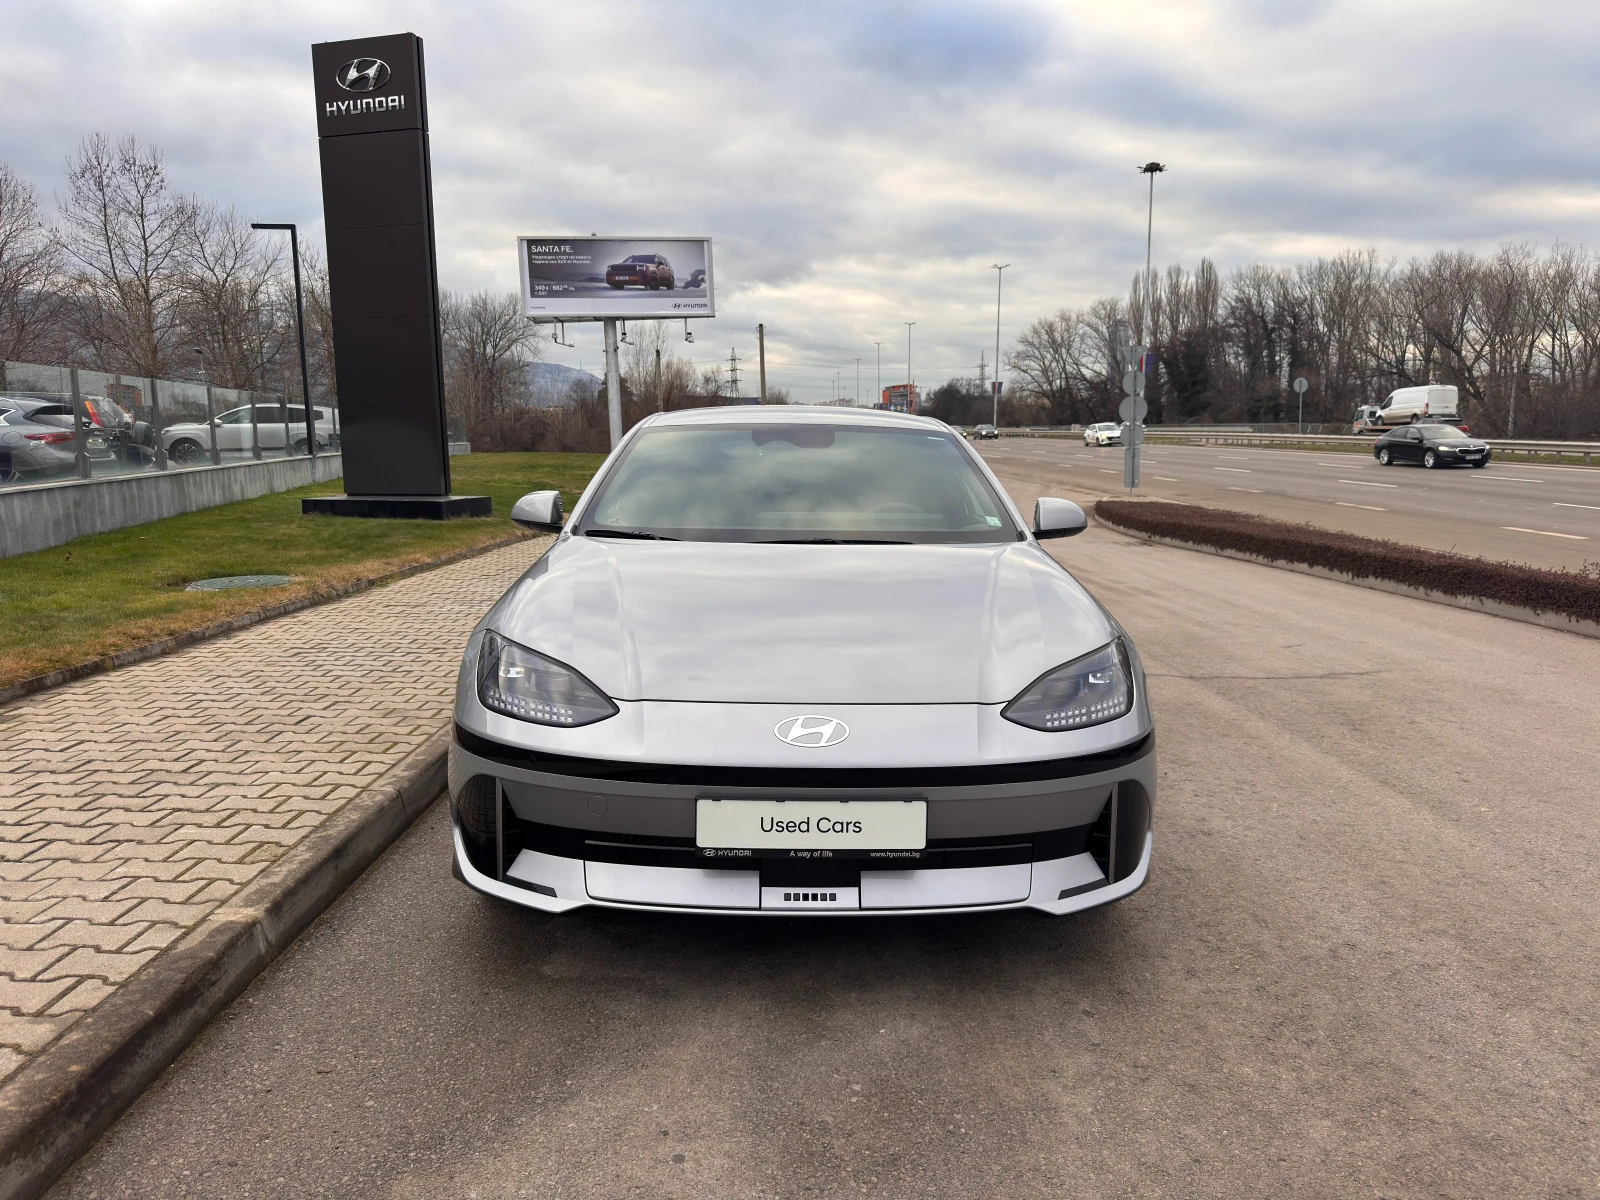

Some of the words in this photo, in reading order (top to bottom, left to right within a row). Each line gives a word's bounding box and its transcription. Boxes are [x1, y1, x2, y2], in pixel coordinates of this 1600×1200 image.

[326, 95, 405, 116] HYUNDAI
[531, 245, 560, 253] SANTA
[760, 816, 810, 833] Used
[816, 816, 863, 833] Cars
[796, 851, 811, 859] way
[869, 851, 921, 859] www.hyundai.bg
